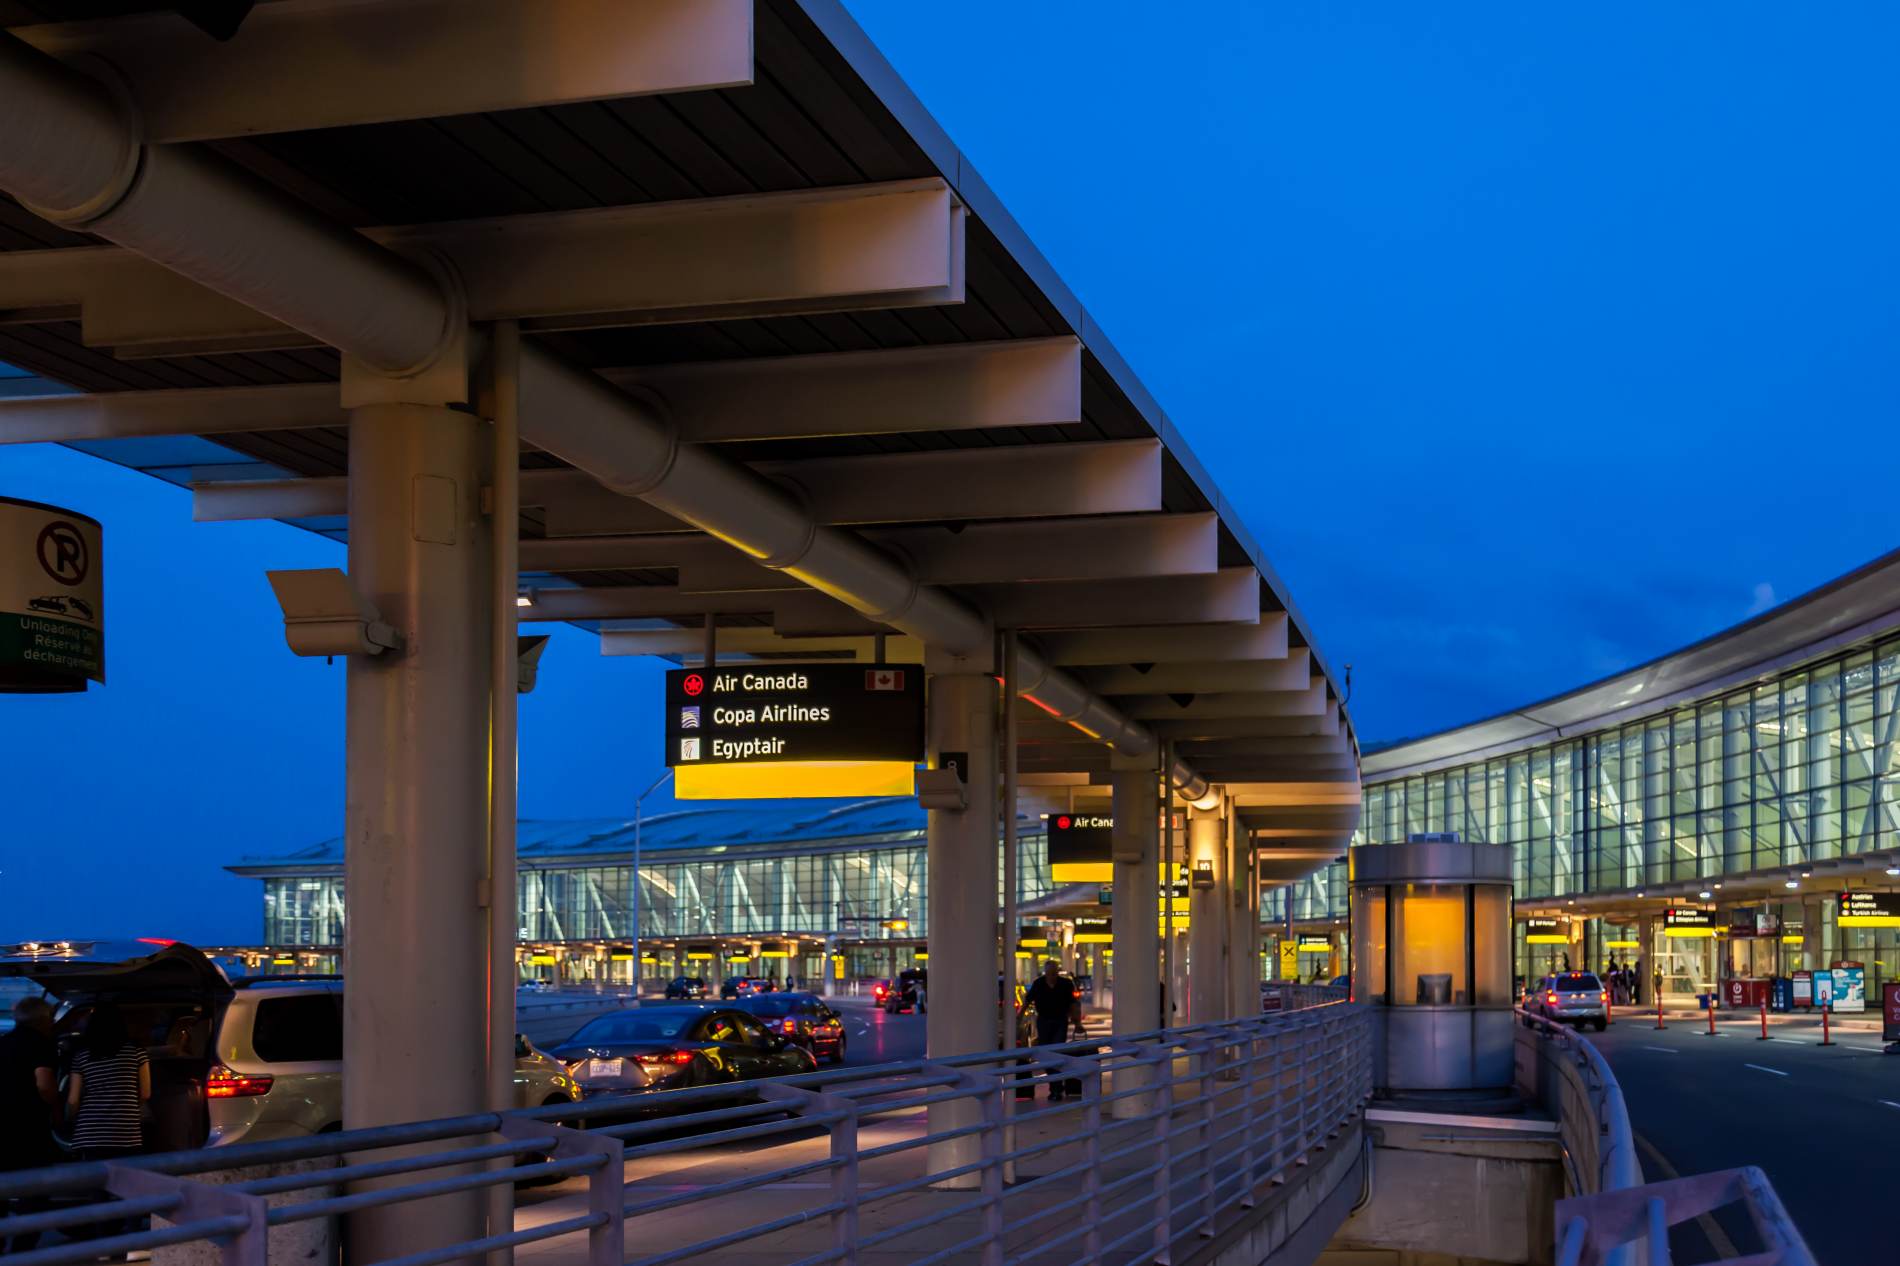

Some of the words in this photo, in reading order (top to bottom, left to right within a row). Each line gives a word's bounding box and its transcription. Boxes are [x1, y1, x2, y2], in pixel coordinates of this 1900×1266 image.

[20, 616, 81, 641] Unloading
[713, 674, 738, 692] Air
[742, 673, 808, 691] Canada
[713, 707, 755, 726] Copa
[760, 704, 830, 722] Airlines
[713, 737, 785, 760] Egyptair
[1074, 817, 1089, 828] Air
